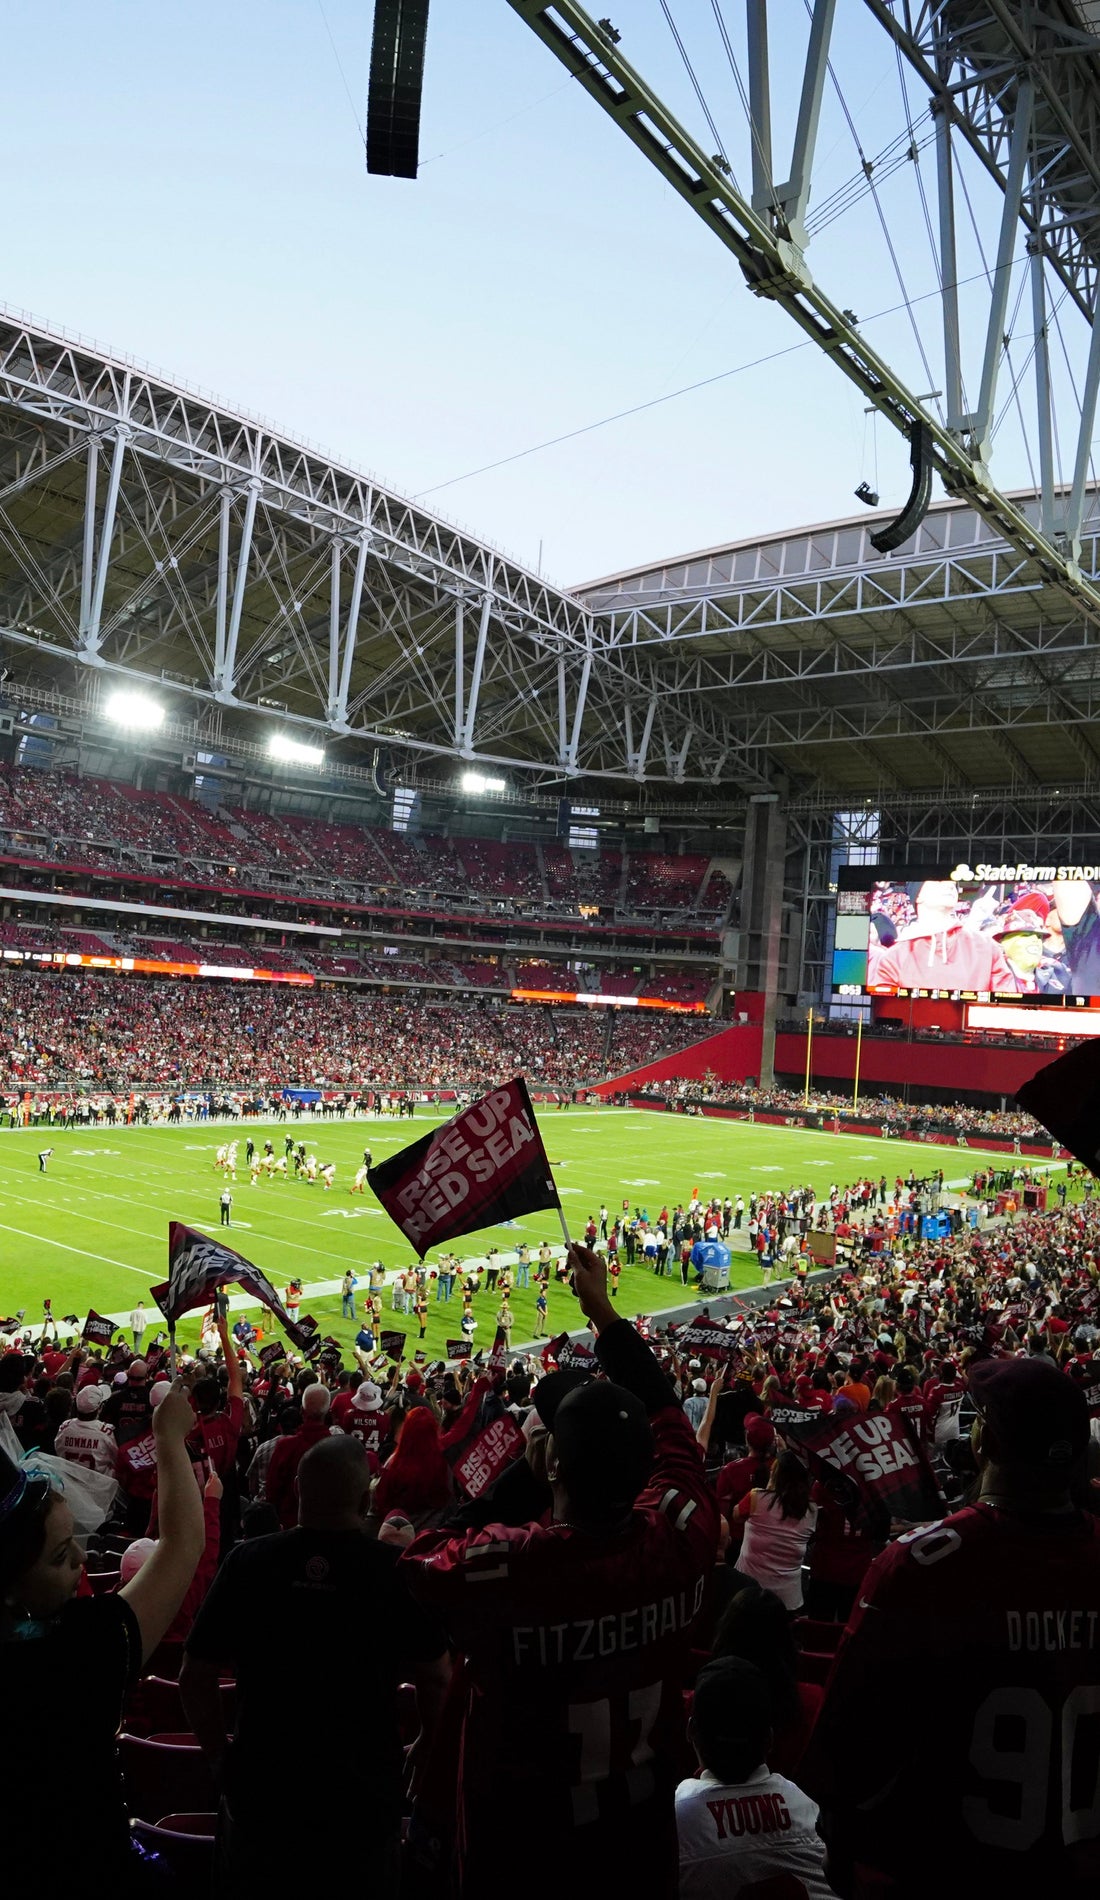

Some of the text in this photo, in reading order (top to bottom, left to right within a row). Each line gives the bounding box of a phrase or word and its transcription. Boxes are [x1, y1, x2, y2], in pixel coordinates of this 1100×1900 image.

[974, 864, 1100, 881] State Farm STADI
[397, 1090, 511, 1214] RISE UP
[401, 1108, 535, 1245] RED SEA!
[680, 1335, 702, 1344] THE
[64, 1437, 99, 1449] BOWMAN
[127, 1435, 155, 1460] RIS
[459, 1420, 506, 1482] RISE UP
[853, 1415, 893, 1447] UP
[465, 1424, 519, 1498] RED SEA!
[856, 1438, 920, 1483] SEA!
[512, 1574, 705, 1668] FITZGERALD
[706, 1793, 792, 1839] YOUNG
